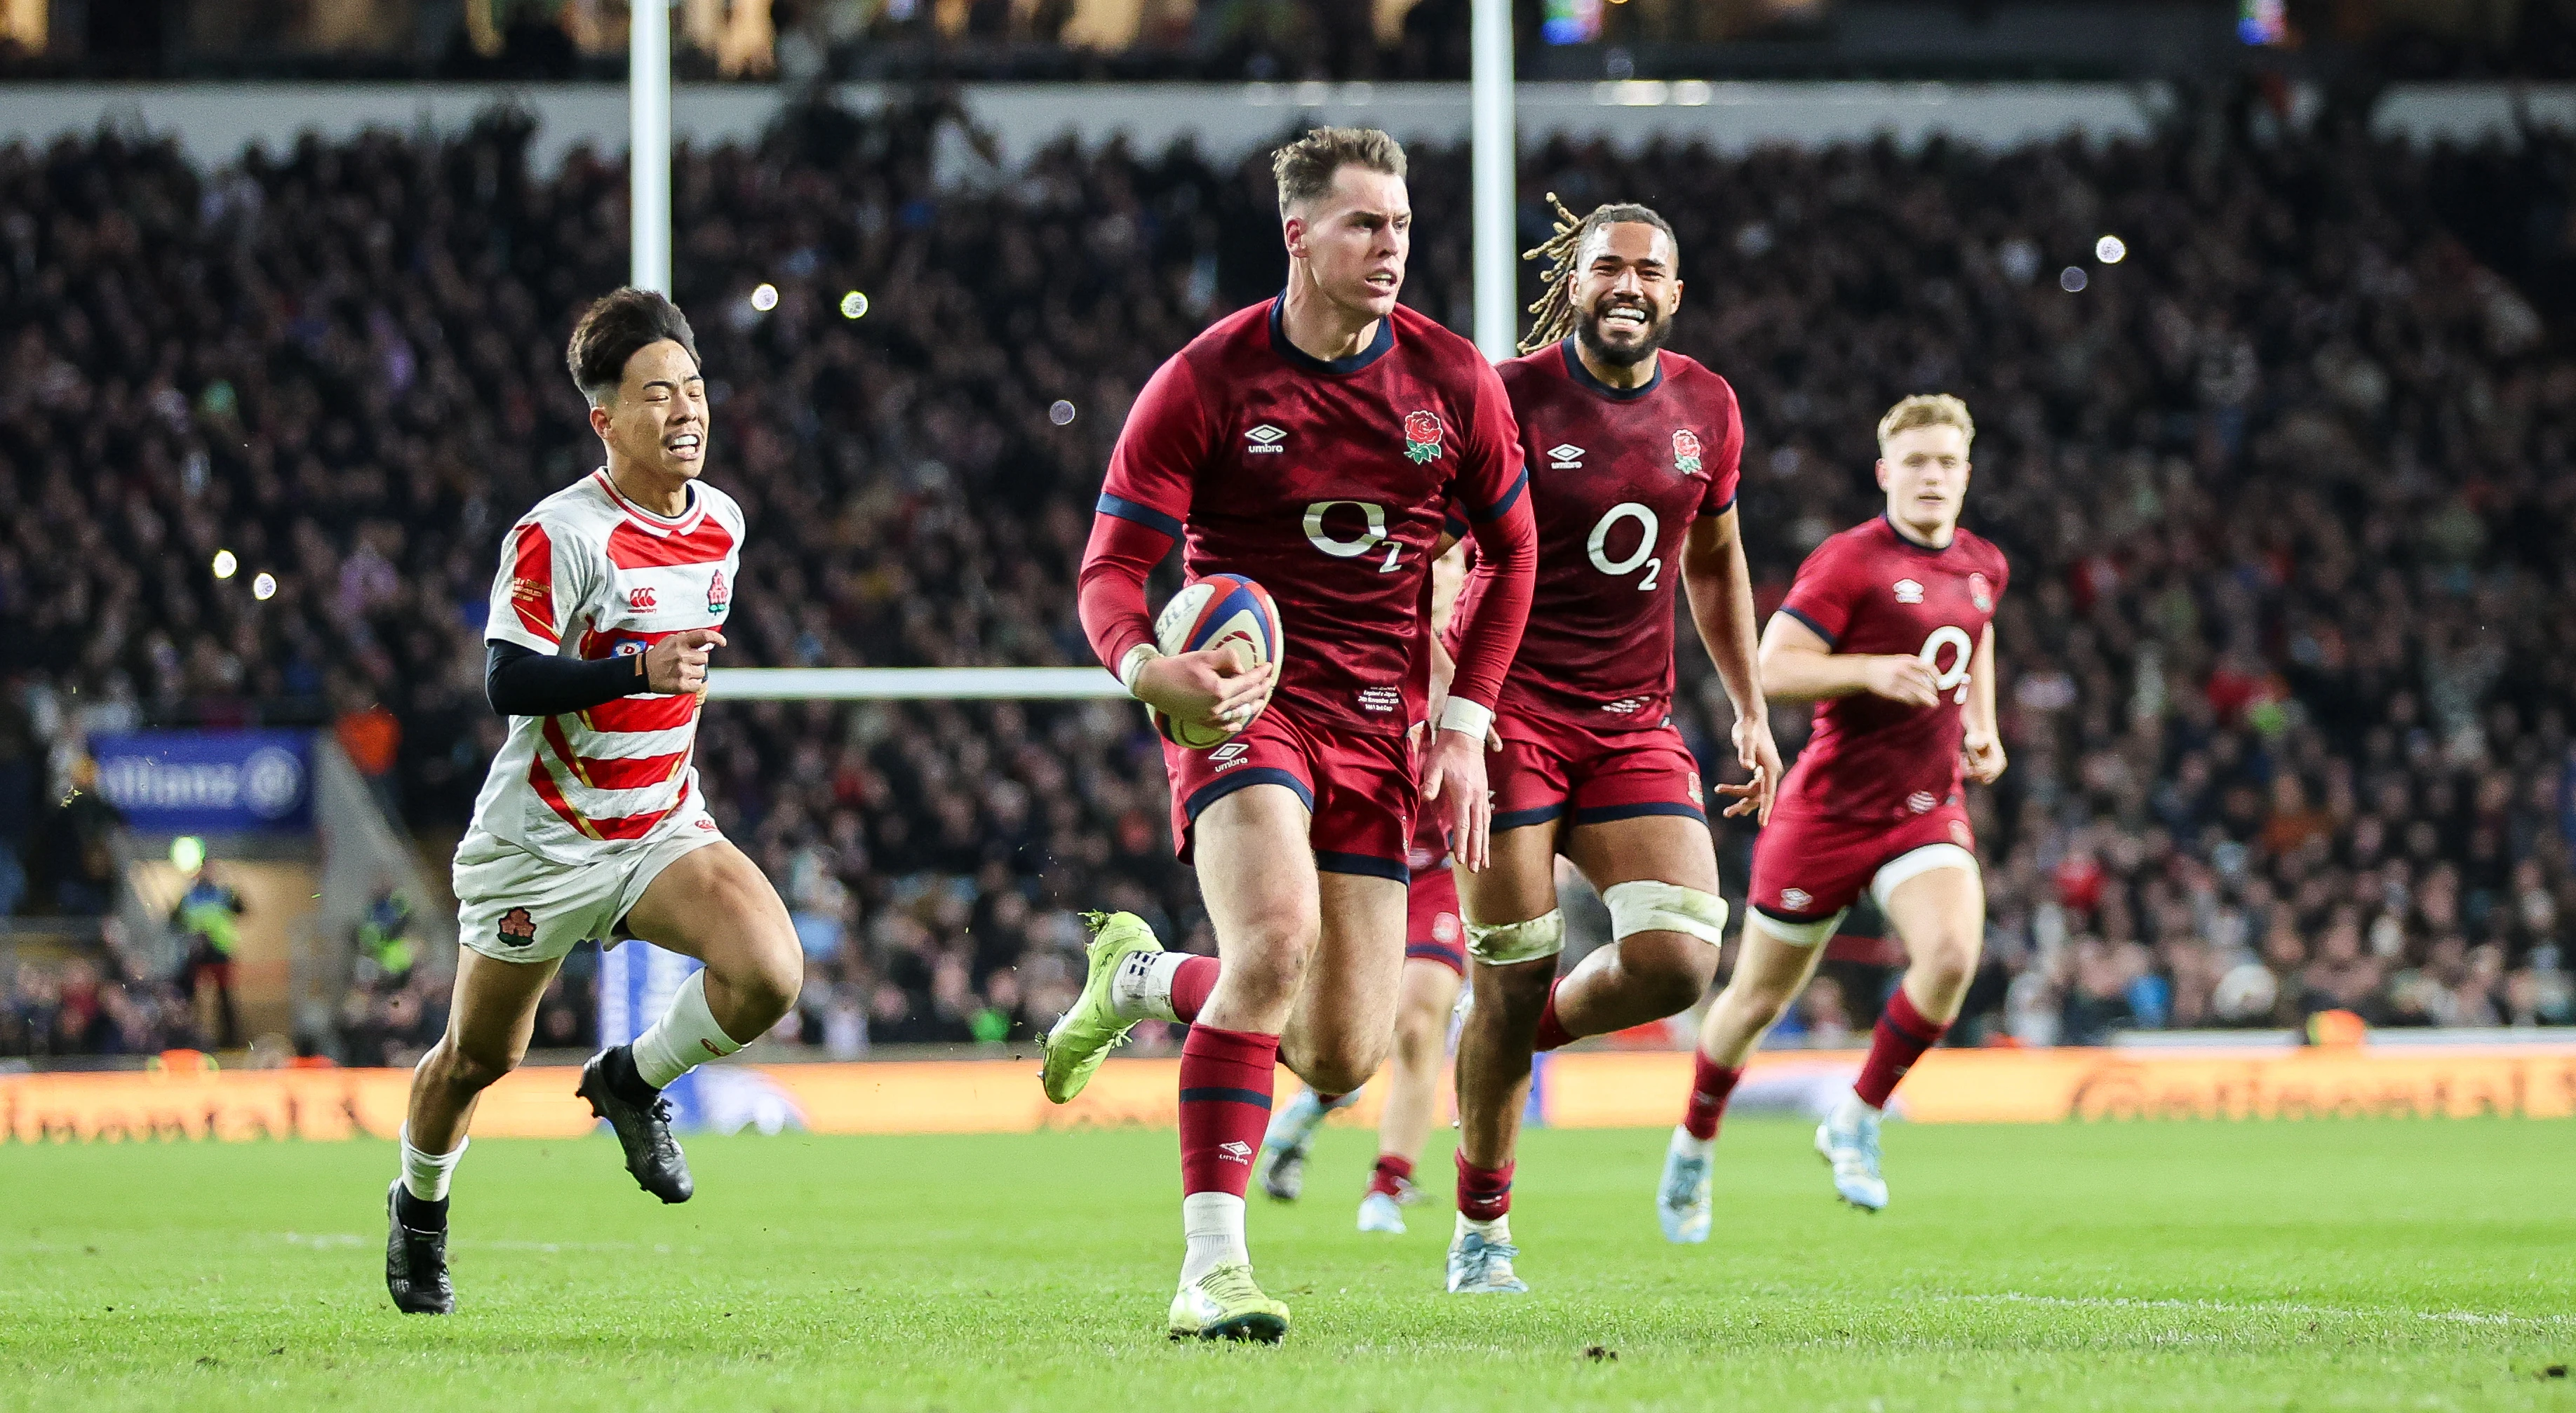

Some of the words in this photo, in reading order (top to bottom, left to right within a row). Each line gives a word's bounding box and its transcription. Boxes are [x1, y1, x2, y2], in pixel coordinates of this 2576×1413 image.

[1248, 443, 1284, 453] umbro
[1587, 502, 1661, 591] O2
[1215, 757, 1248, 772] umbro
[1219, 1153, 1248, 1165] umbro
